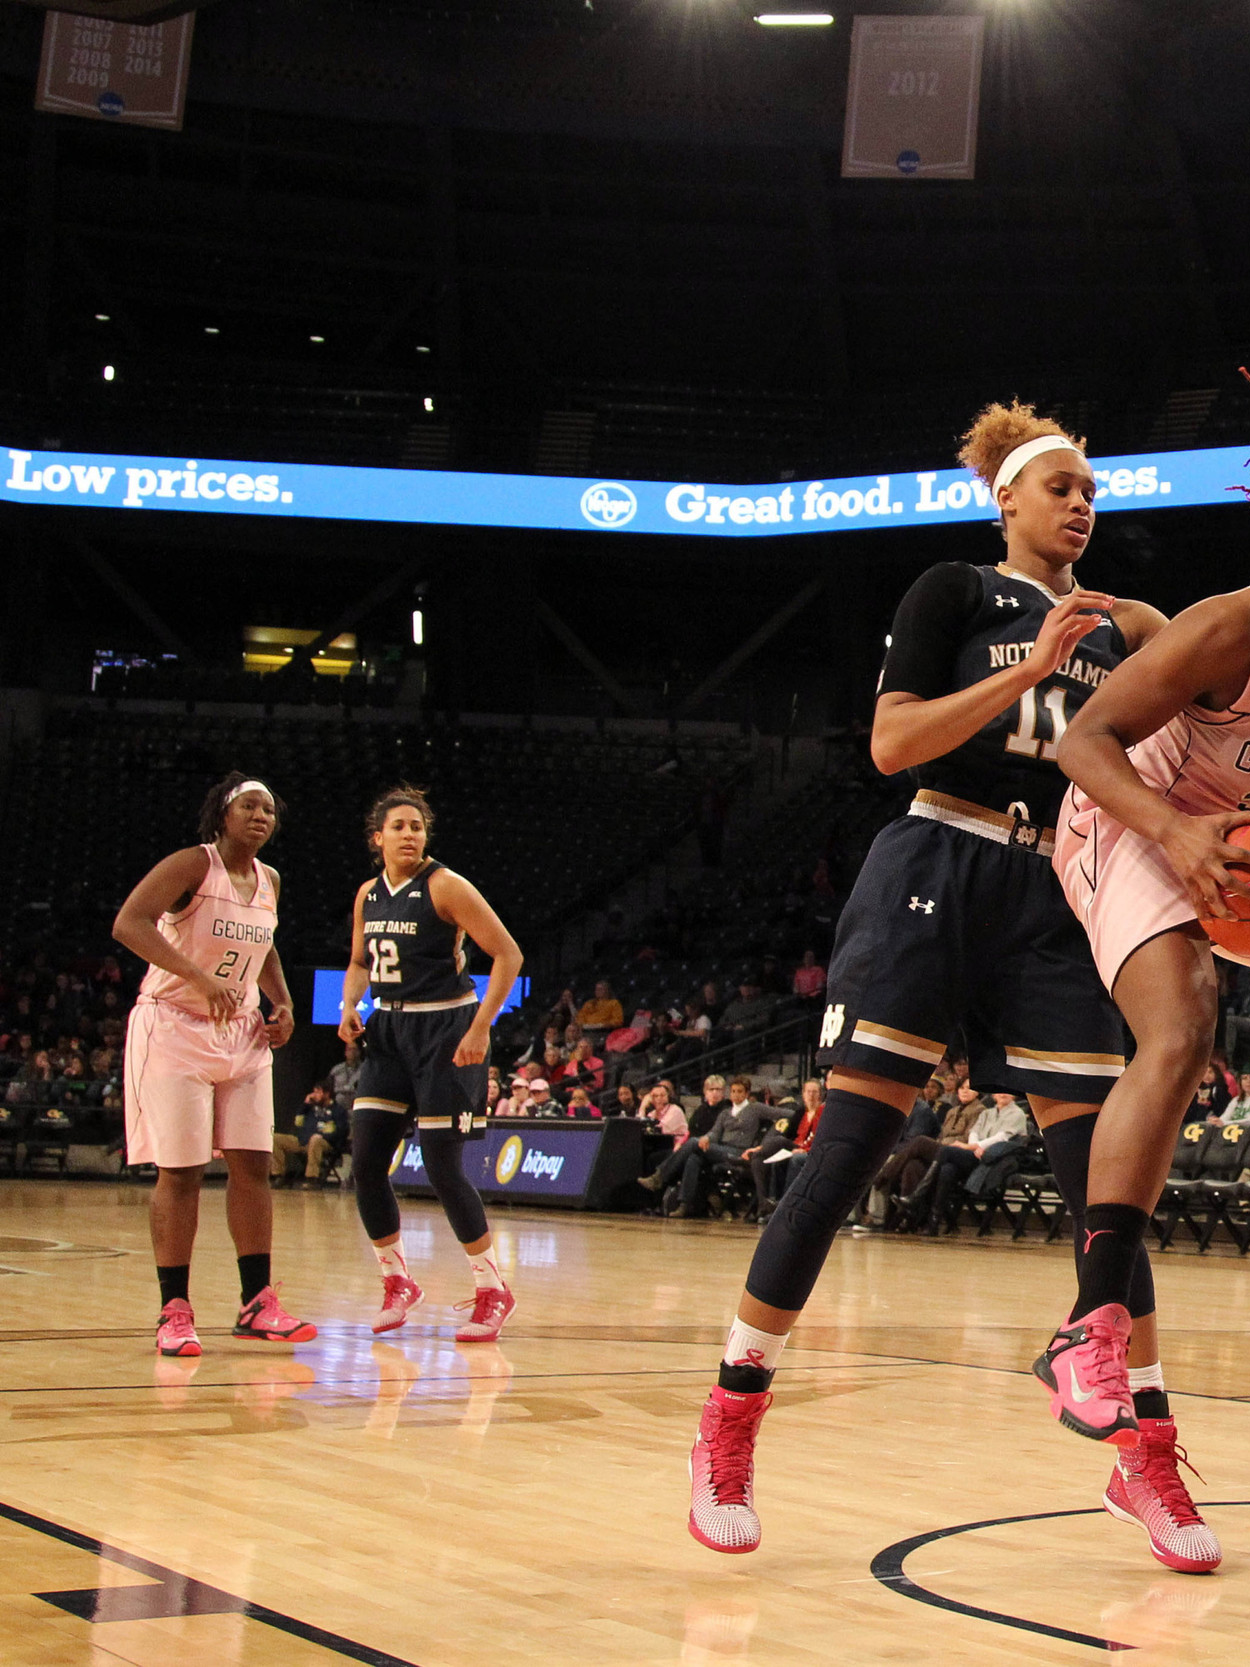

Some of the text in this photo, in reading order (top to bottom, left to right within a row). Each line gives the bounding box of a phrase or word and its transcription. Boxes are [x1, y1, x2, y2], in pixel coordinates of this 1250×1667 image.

[72, 28, 112, 49] 2007
[69, 48, 162, 77] 2008 2014
[67, 67, 109, 88] 2009
[888, 71, 940, 96] 2012
[6, 450, 293, 507] Low prices.
[665, 484, 794, 524] Great
[802, 476, 903, 521] food.
[989, 641, 1035, 668] NOT
[386, 920, 417, 935] DAME
[214, 951, 252, 982] 21
[368, 938, 402, 983] 12
[521, 1149, 565, 1181] bitpay
